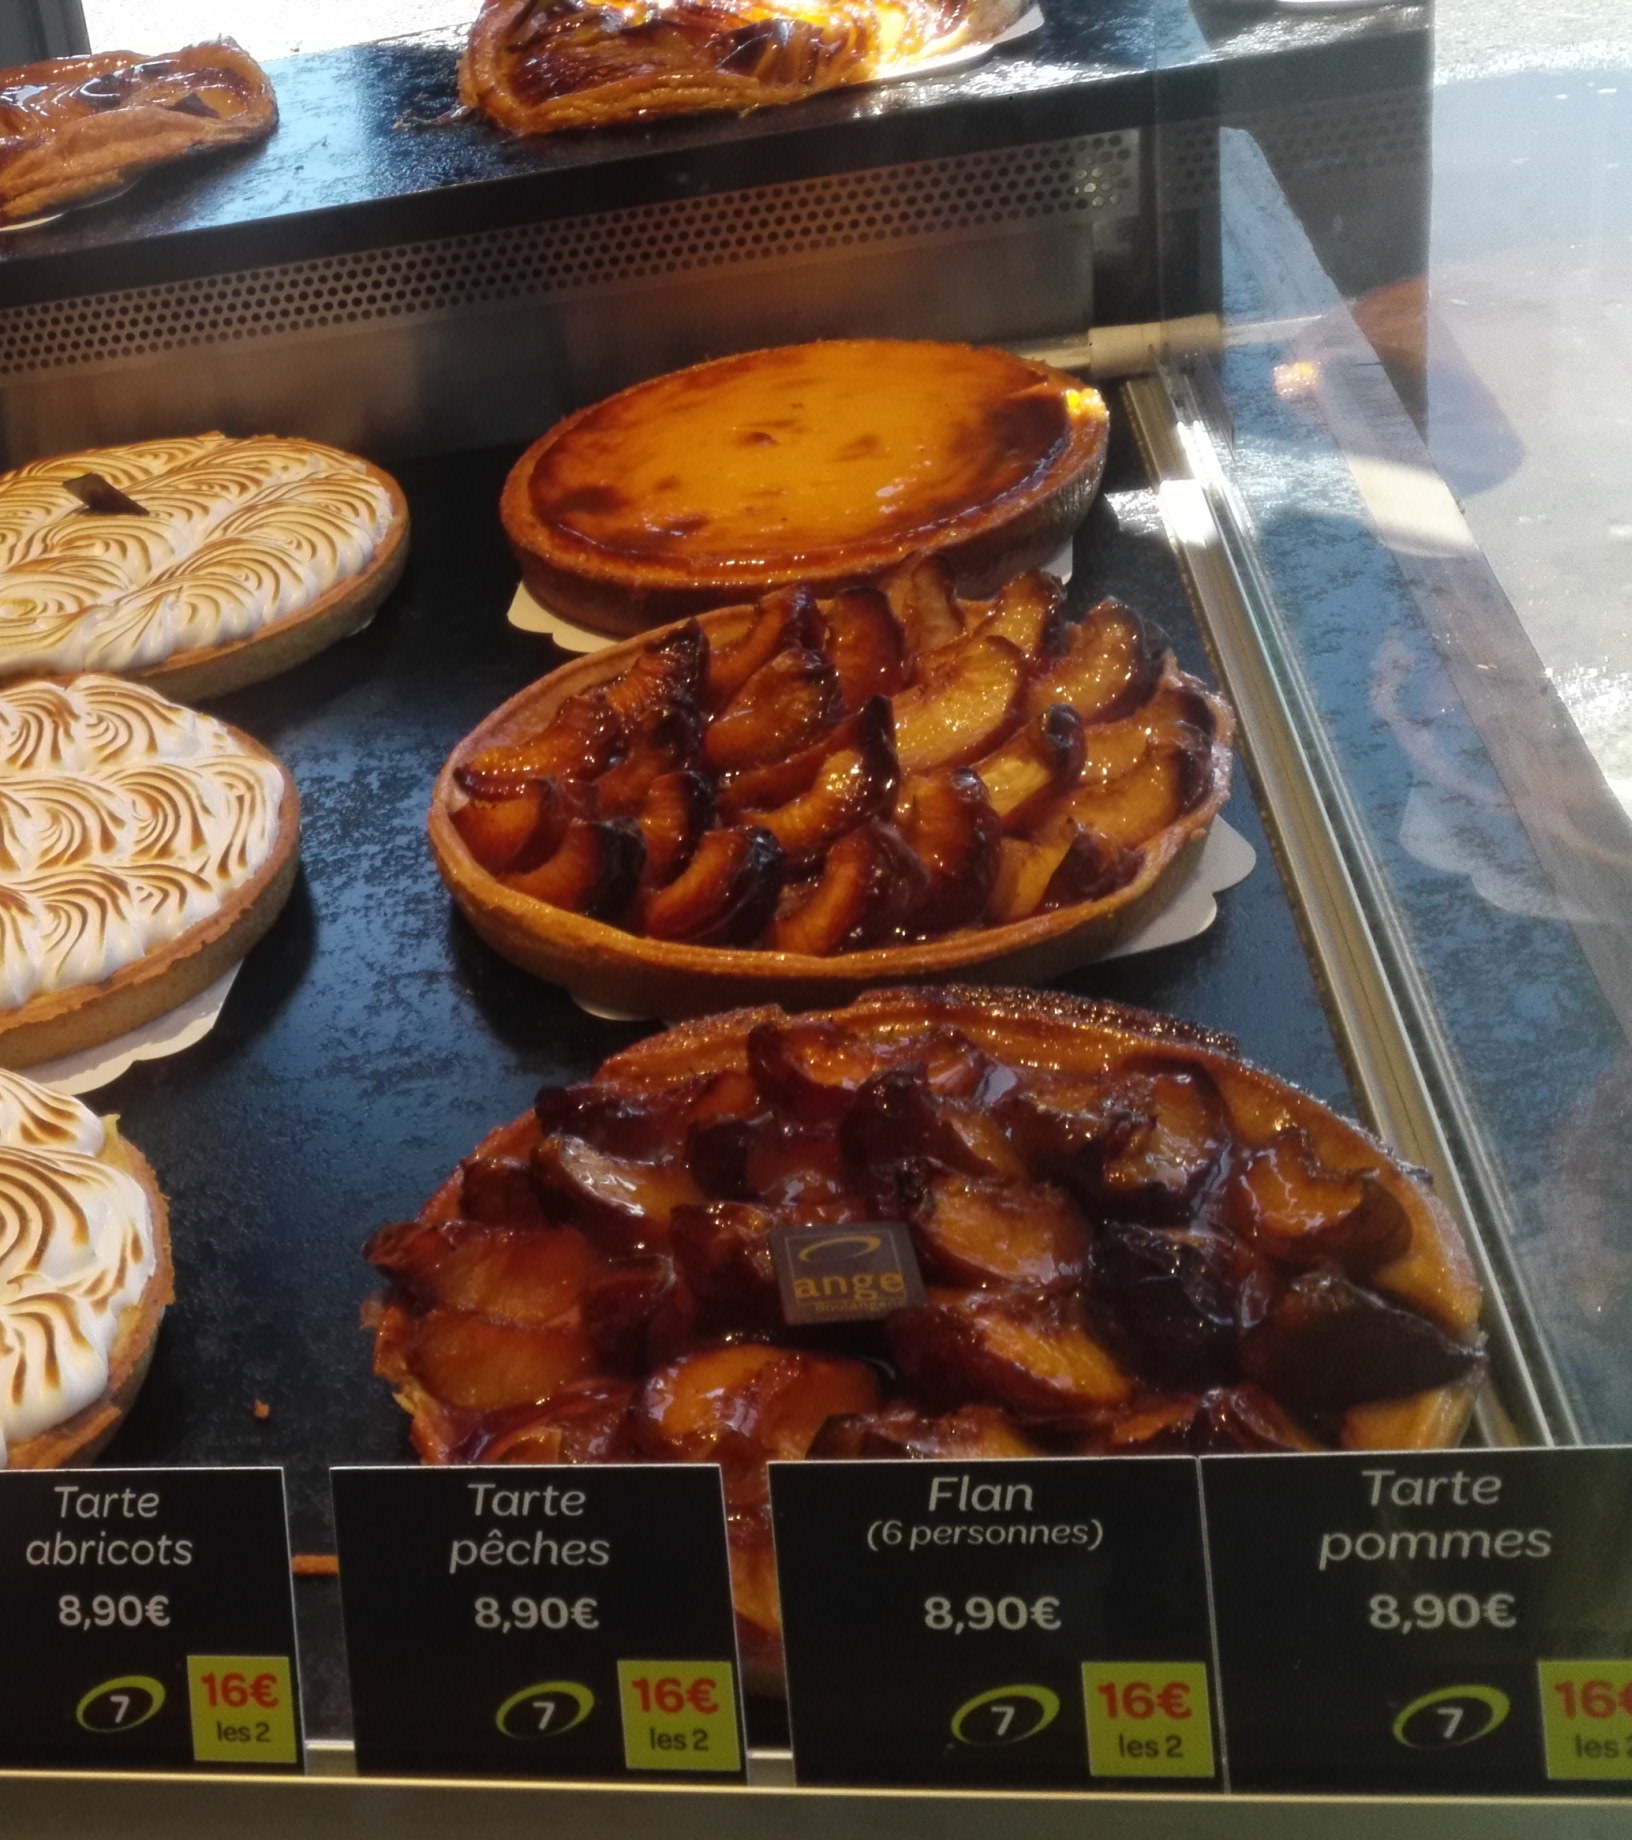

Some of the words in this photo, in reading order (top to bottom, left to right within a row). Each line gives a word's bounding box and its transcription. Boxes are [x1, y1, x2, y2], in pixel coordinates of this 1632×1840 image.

[792, 1271, 906, 1301] ange
[54, 1486, 159, 1518] Tarte
[468, 1484, 585, 1516] Tarte
[929, 1475, 1032, 1511] Flan
[1362, 1470, 1501, 1506] Tarte
[26, 1531, 192, 1565] abricots
[450, 1529, 609, 1574] pêches
[868, 1520, 902, 1551] (6
[910, 1519, 1103, 1550] personnes)
[1319, 1529, 1551, 1570] pommes
[59, 1595, 170, 1630] 8,90€
[475, 1597, 599, 1633] 8,90€
[925, 1596, 1061, 1634] 8,90€
[1370, 1593, 1516, 1634] 8,90€
[201, 1673, 278, 1708] 16€
[632, 1678, 718, 1714] 16€
[1096, 1681, 1191, 1720] 16€
[110, 1695, 129, 1723] 7
[533, 1702, 555, 1729] 7
[991, 1706, 1014, 1735] 7
[1438, 1708, 1463, 1738] 7
[217, 1721, 251, 1742] les
[255, 1722, 270, 1742] 2
[650, 1727, 687, 1750] les
[692, 1728, 708, 1751] 2
[1118, 1733, 1159, 1758] les
[1166, 1734, 1183, 1758] 2
[1574, 1734, 1619, 1759] les
